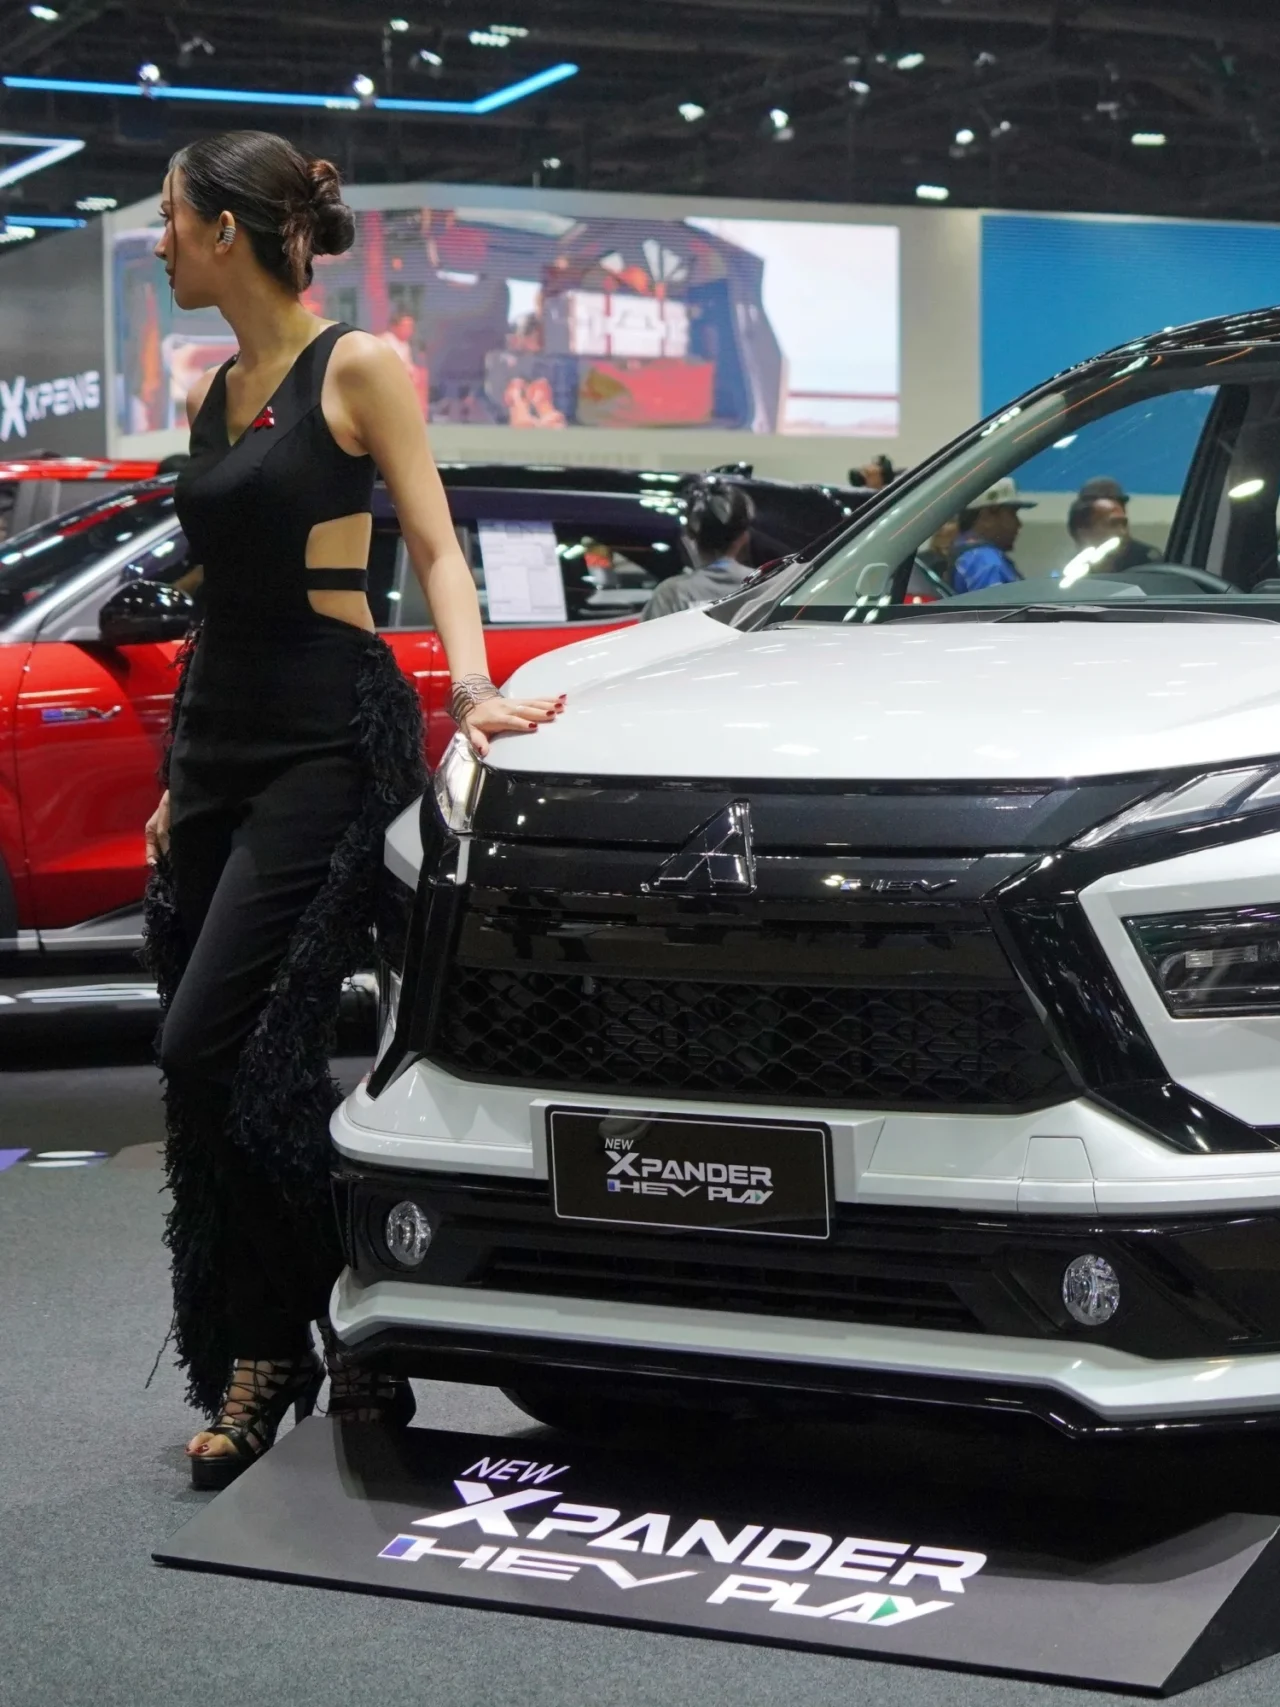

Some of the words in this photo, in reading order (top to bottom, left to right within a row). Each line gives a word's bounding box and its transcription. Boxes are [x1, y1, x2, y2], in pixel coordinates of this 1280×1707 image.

[25, 370, 100, 422] XPENG
[604, 1138, 634, 1150] NEW
[605, 1150, 774, 1187] XPANDER
[606, 1179, 700, 1197] HEV
[707, 1186, 774, 1205] PLAY
[461, 1456, 570, 1485] NEW
[411, 1480, 988, 1594] XPANDER
[377, 1533, 706, 1590] HEV
[706, 1574, 955, 1627] PLAY
